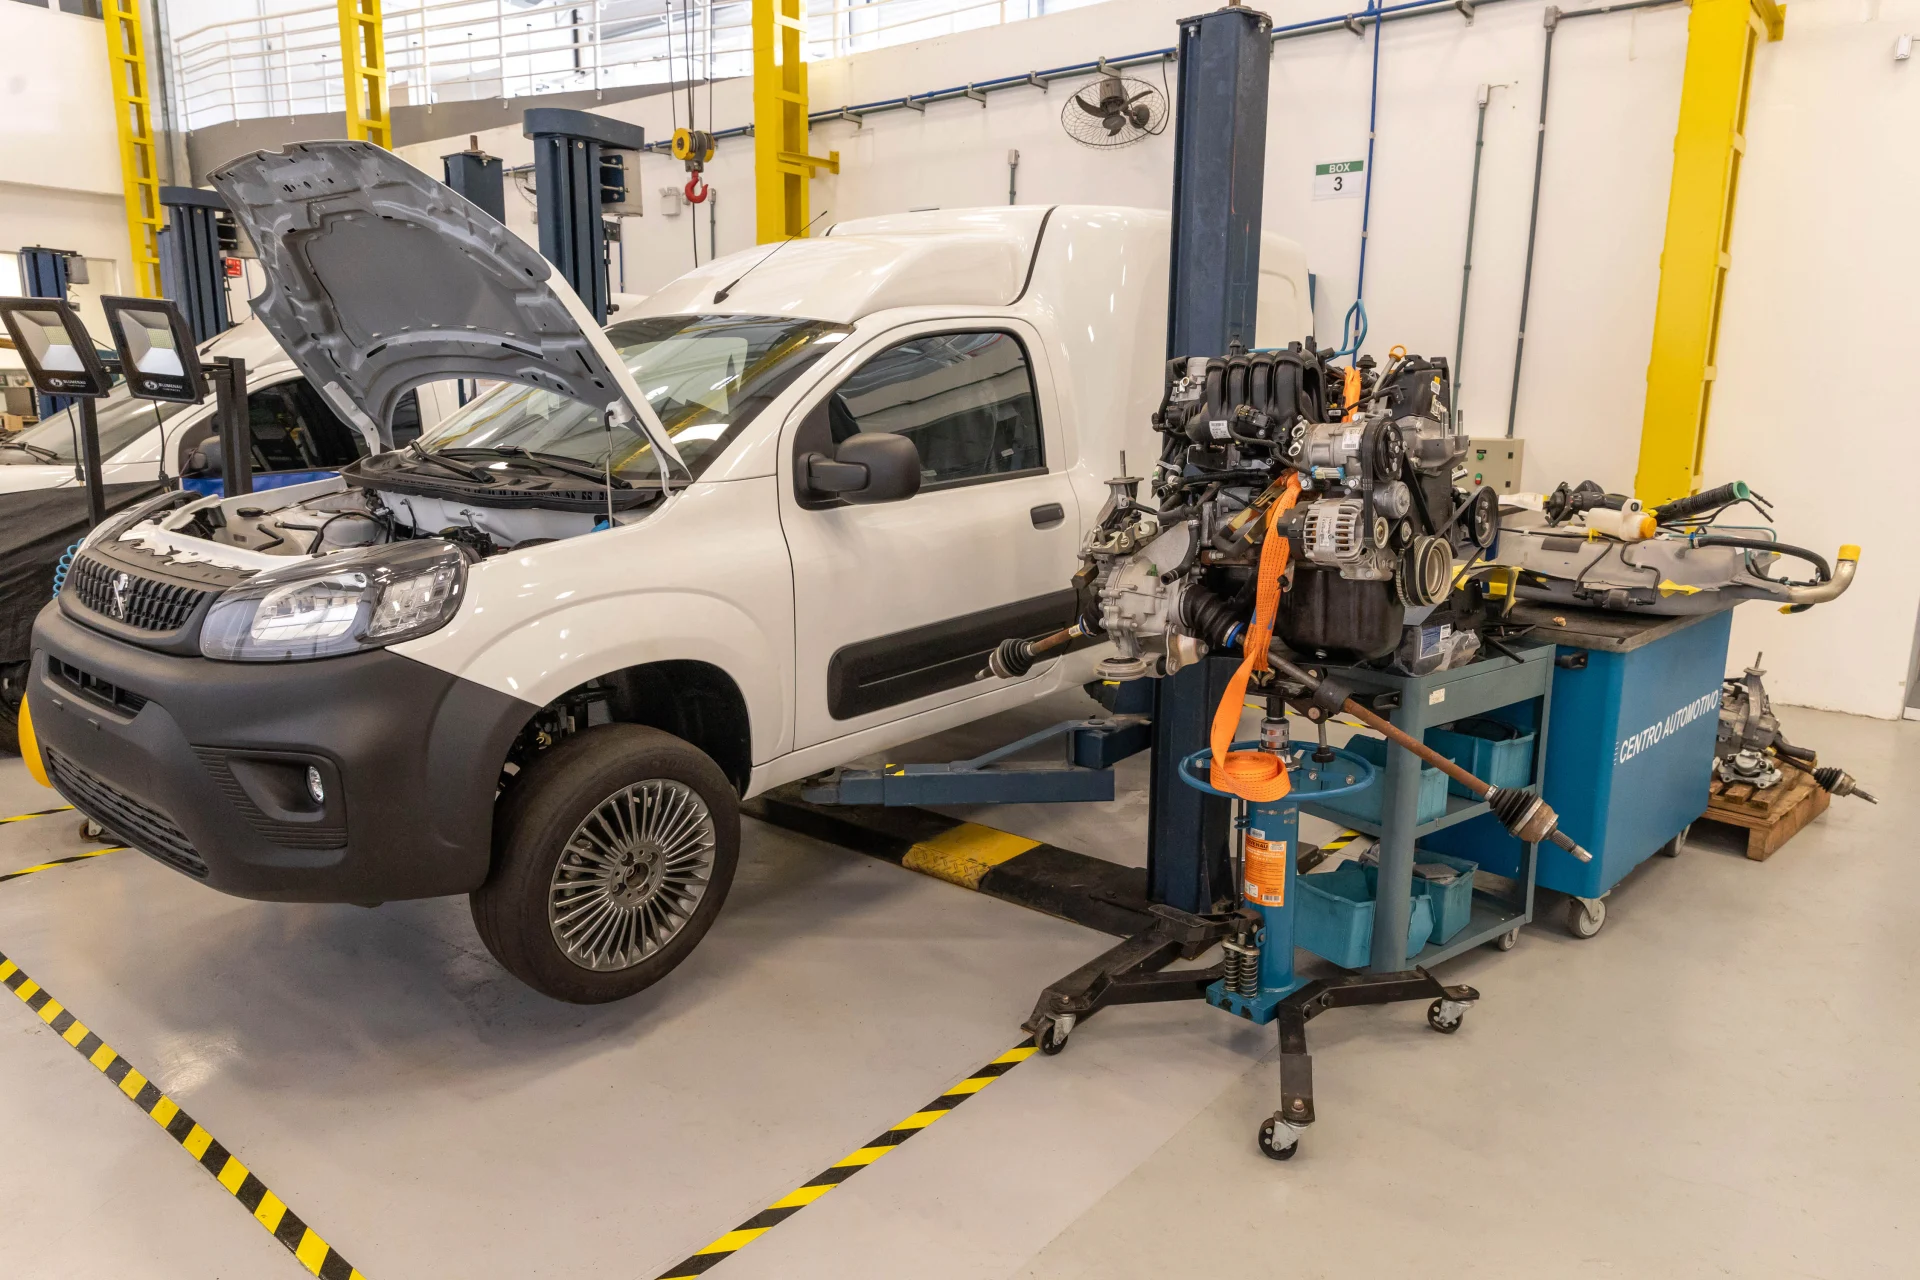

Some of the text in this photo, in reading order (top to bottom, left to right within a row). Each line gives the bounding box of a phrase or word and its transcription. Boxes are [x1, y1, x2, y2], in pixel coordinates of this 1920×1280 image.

[1329, 163, 1350, 173] BOX
[1333, 176, 1343, 191] 3
[1619, 689, 1719, 764] CENTRO AUTOMOTIVO
[1246, 837, 1268, 849] VENAU
